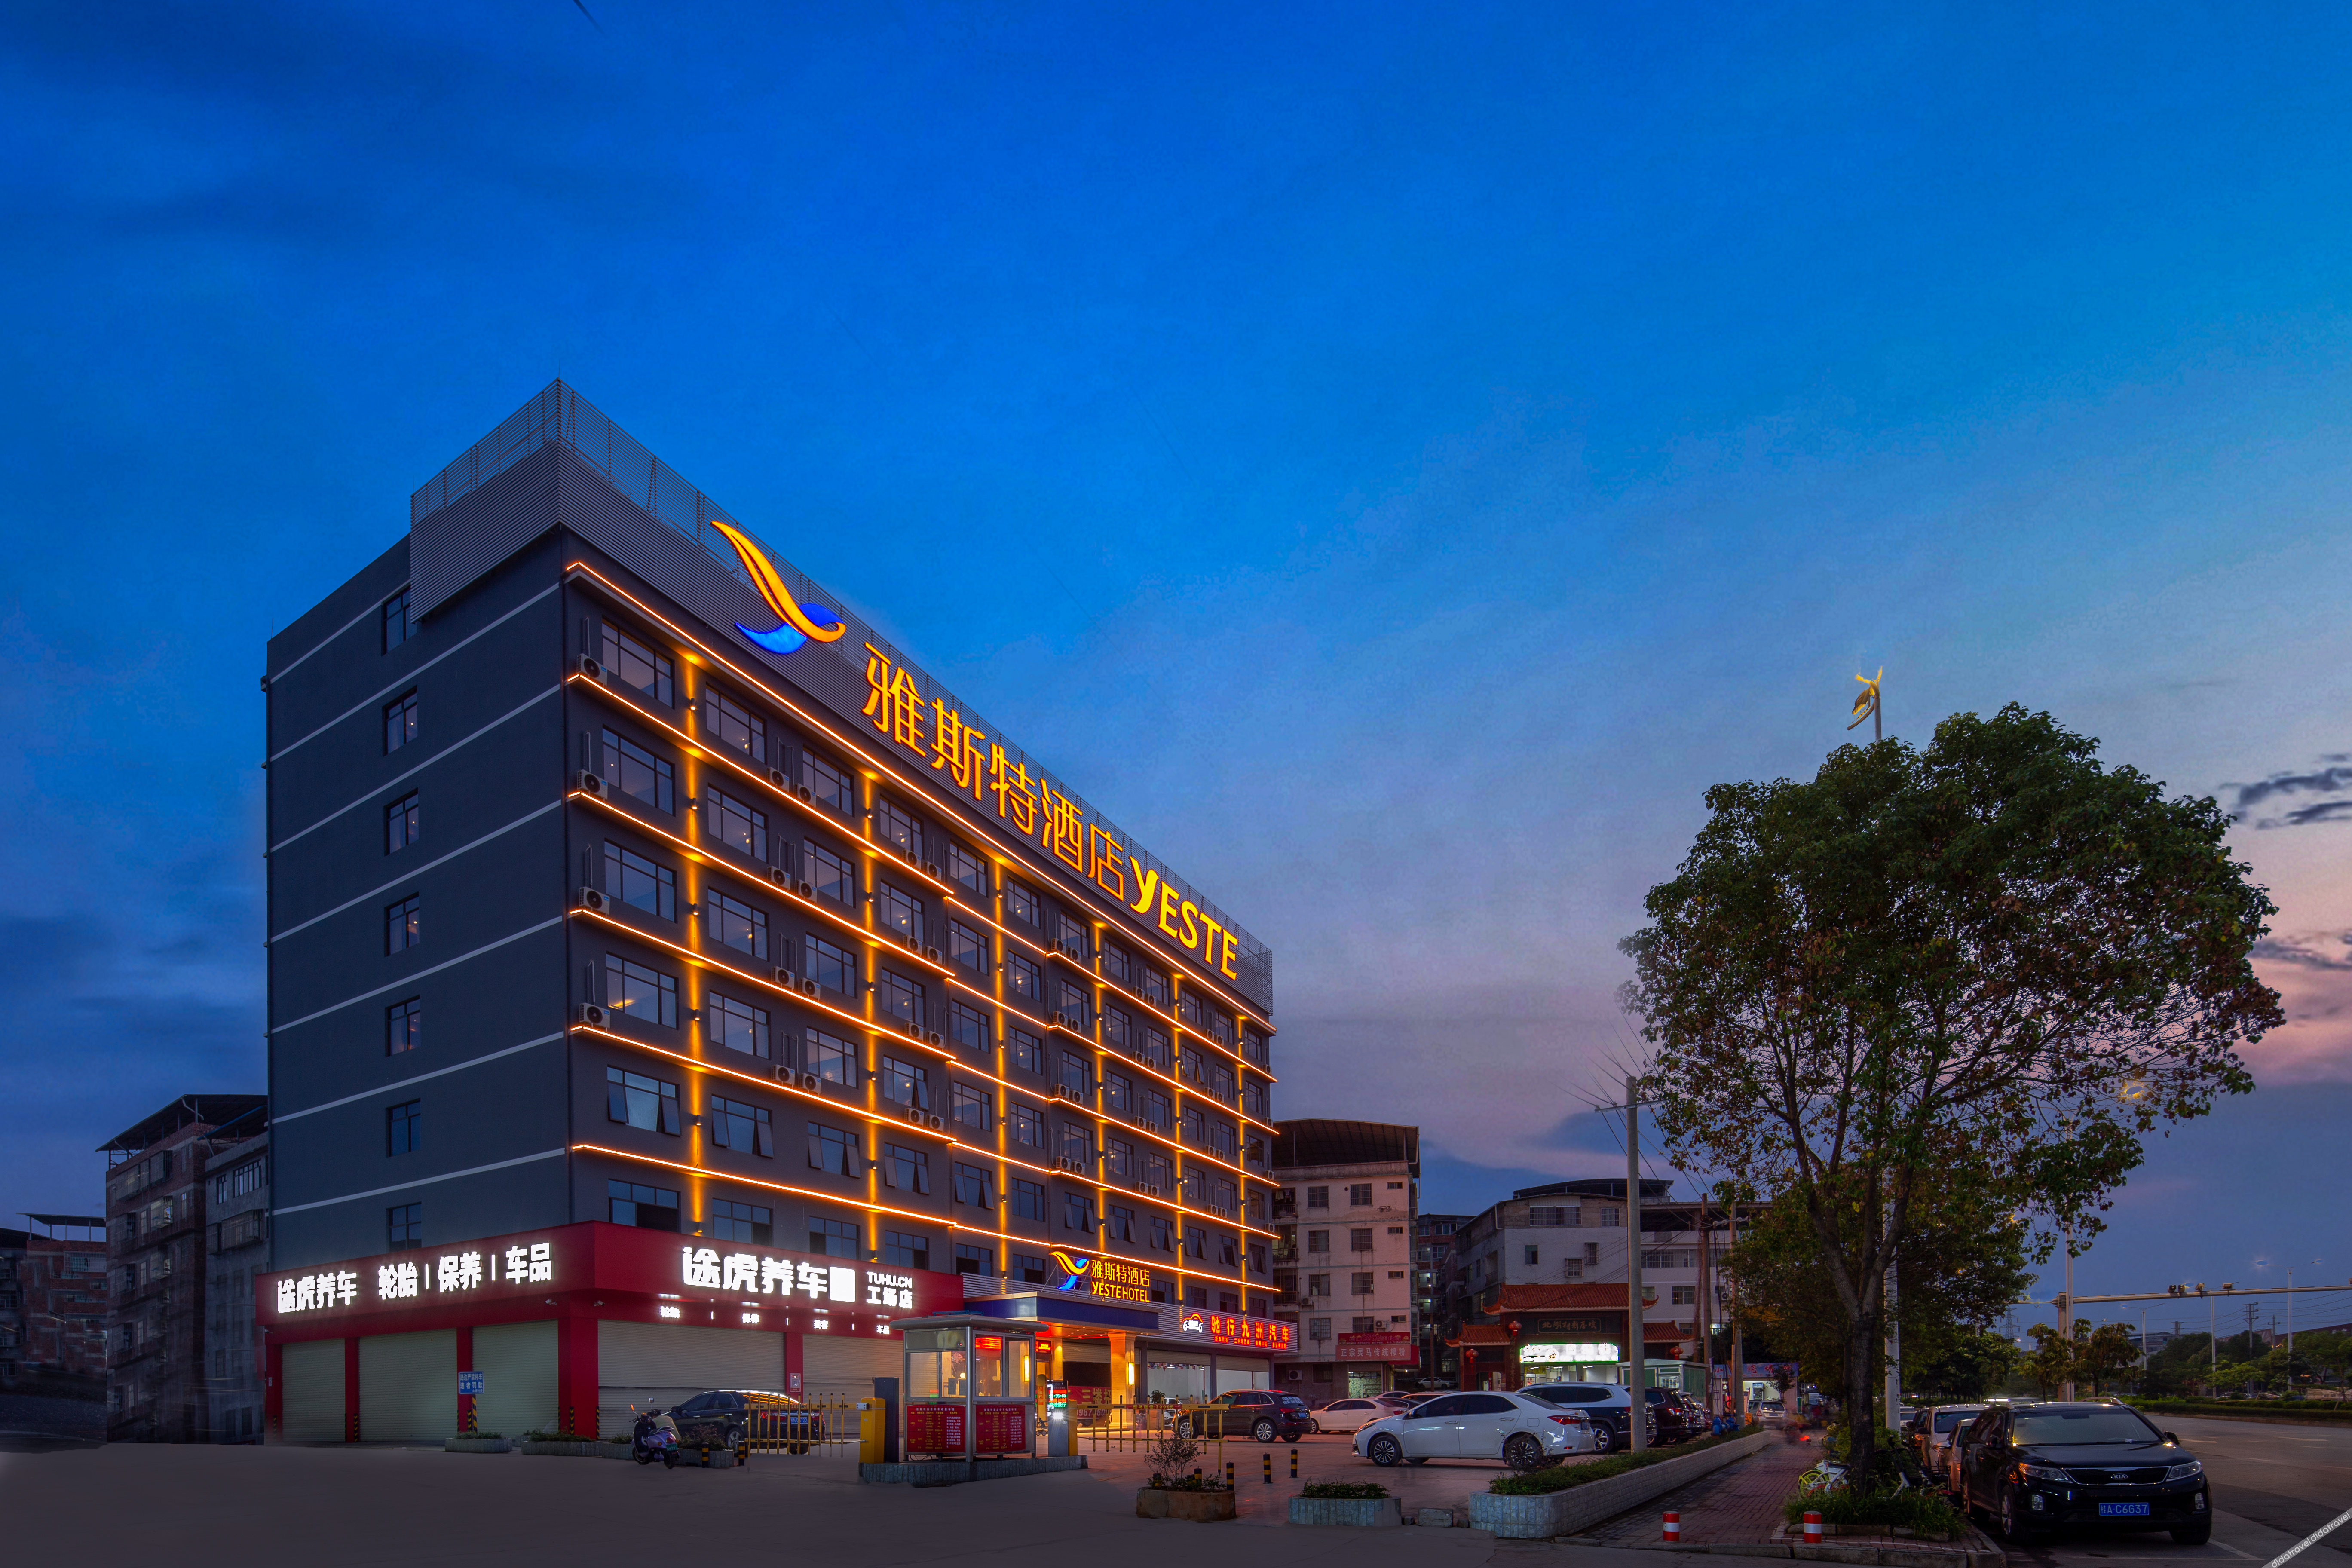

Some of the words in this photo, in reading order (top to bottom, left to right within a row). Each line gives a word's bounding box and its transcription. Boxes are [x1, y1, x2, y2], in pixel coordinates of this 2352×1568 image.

[862, 642, 1124, 901] 雅斯特酒店
[1129, 856, 1238, 980] YESTE
[278, 1271, 357, 1313] 途虎养车
[378, 1262, 418, 1300] 轮胎
[438, 1251, 481, 1292] 保养
[505, 1243, 552, 1284] 车品
[683, 1246, 827, 1298] 途虎养车
[867, 1271, 913, 1289] TUHU.CN
[1091, 1259, 1150, 1287] 雅斯特酒店
[867, 1286, 913, 1309] 工场店
[1341, 1347, 1406, 1357] 正宗灵马传统榨粉
